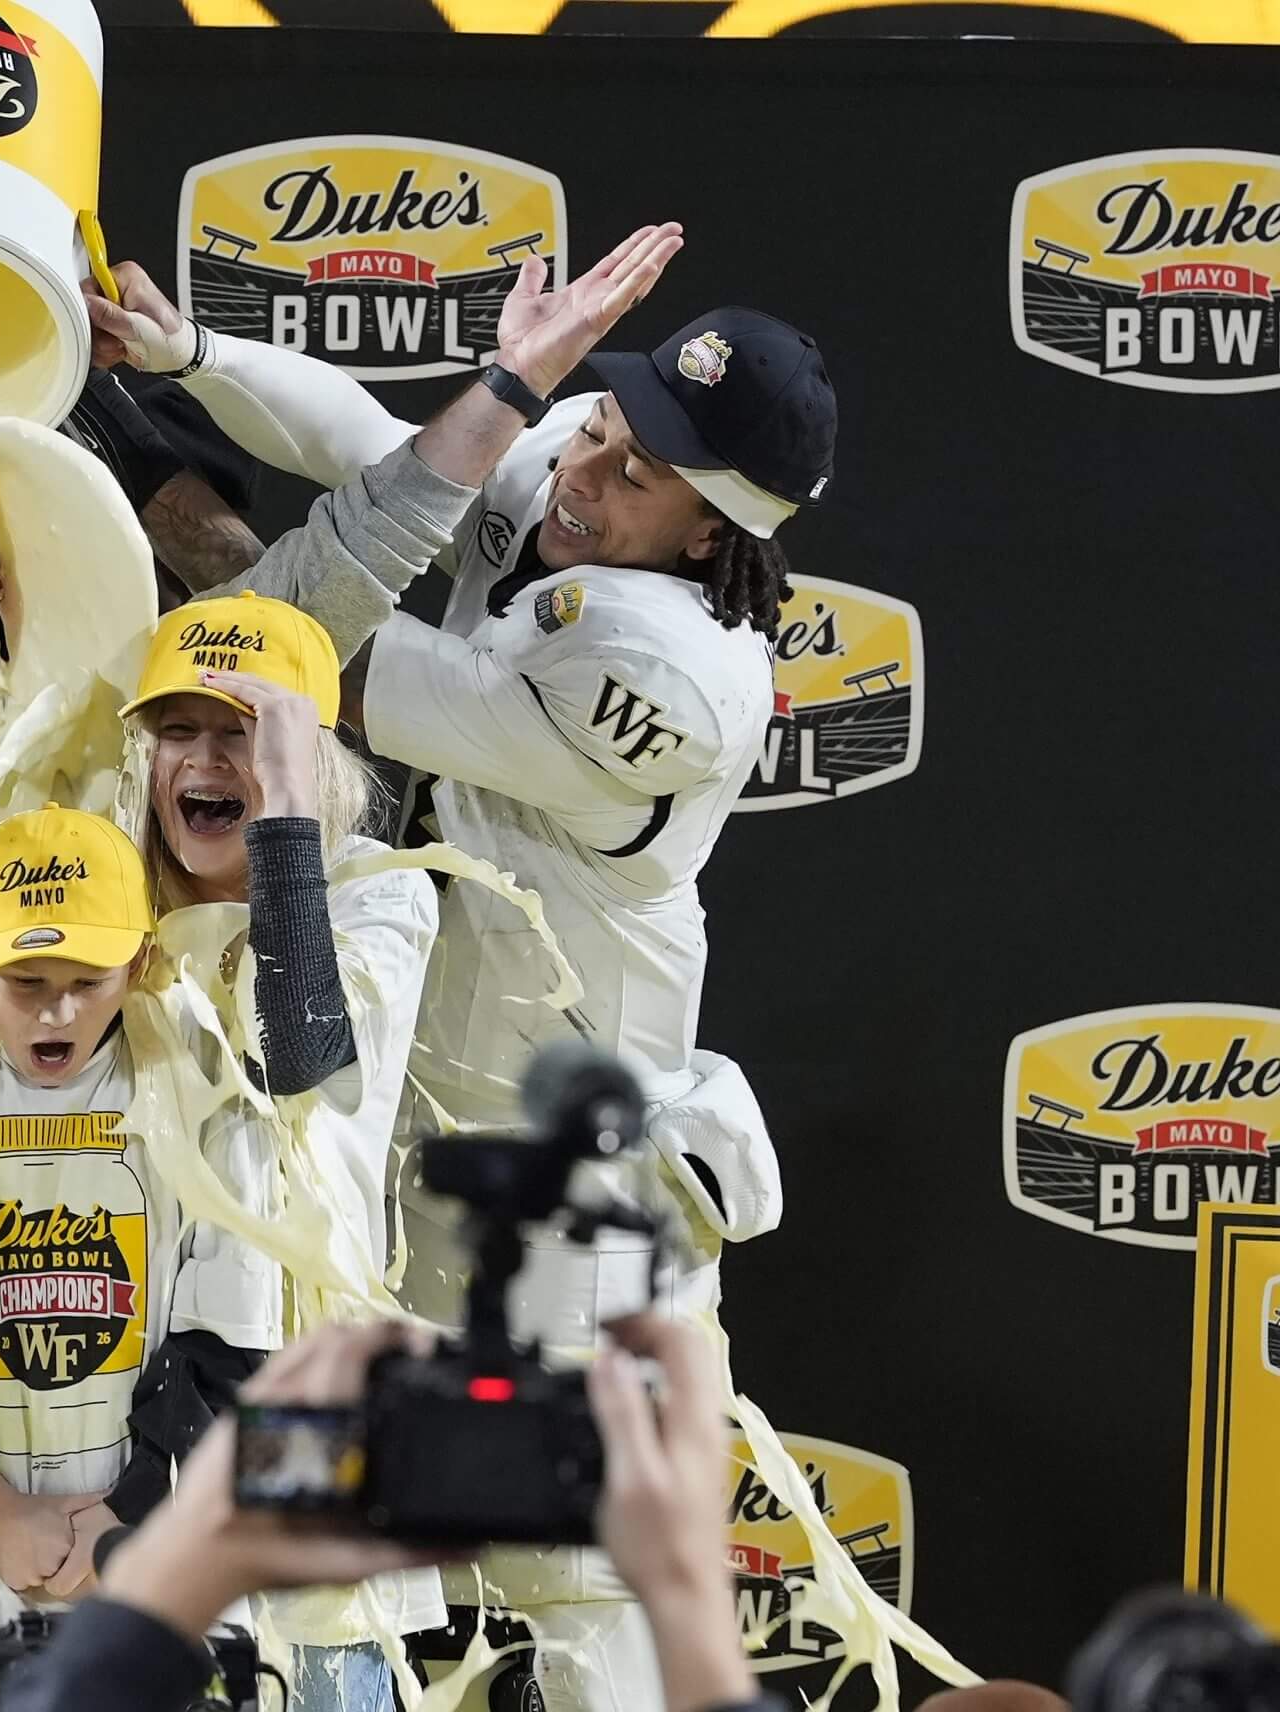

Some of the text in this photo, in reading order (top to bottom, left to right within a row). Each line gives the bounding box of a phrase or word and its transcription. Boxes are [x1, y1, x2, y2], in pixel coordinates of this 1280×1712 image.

[263, 164, 488, 242] Duke's
[1096, 177, 1280, 255] Duke
[340, 255, 402, 275] MAYO
[1174, 268, 1237, 288] MAYO
[272, 294, 474, 360] BOWL
[1105, 306, 1263, 369] BOW
[177, 620, 267, 652] Duke's
[192, 650, 238, 672] MAYO
[591, 675, 684, 769] WF
[0, 855, 90, 893] Duke's
[19, 887, 65, 909] MAYO
[1091, 1034, 1280, 1111] Duke
[1169, 1123, 1233, 1143] MAYO
[1099, 1163, 1258, 1225] BOW
[51, 1251, 113, 1268] BOWL
[0, 1276, 105, 1315] CHAMPIONS
[15, 1322, 86, 1382] WF
[96, 1331, 111, 1345] 26
